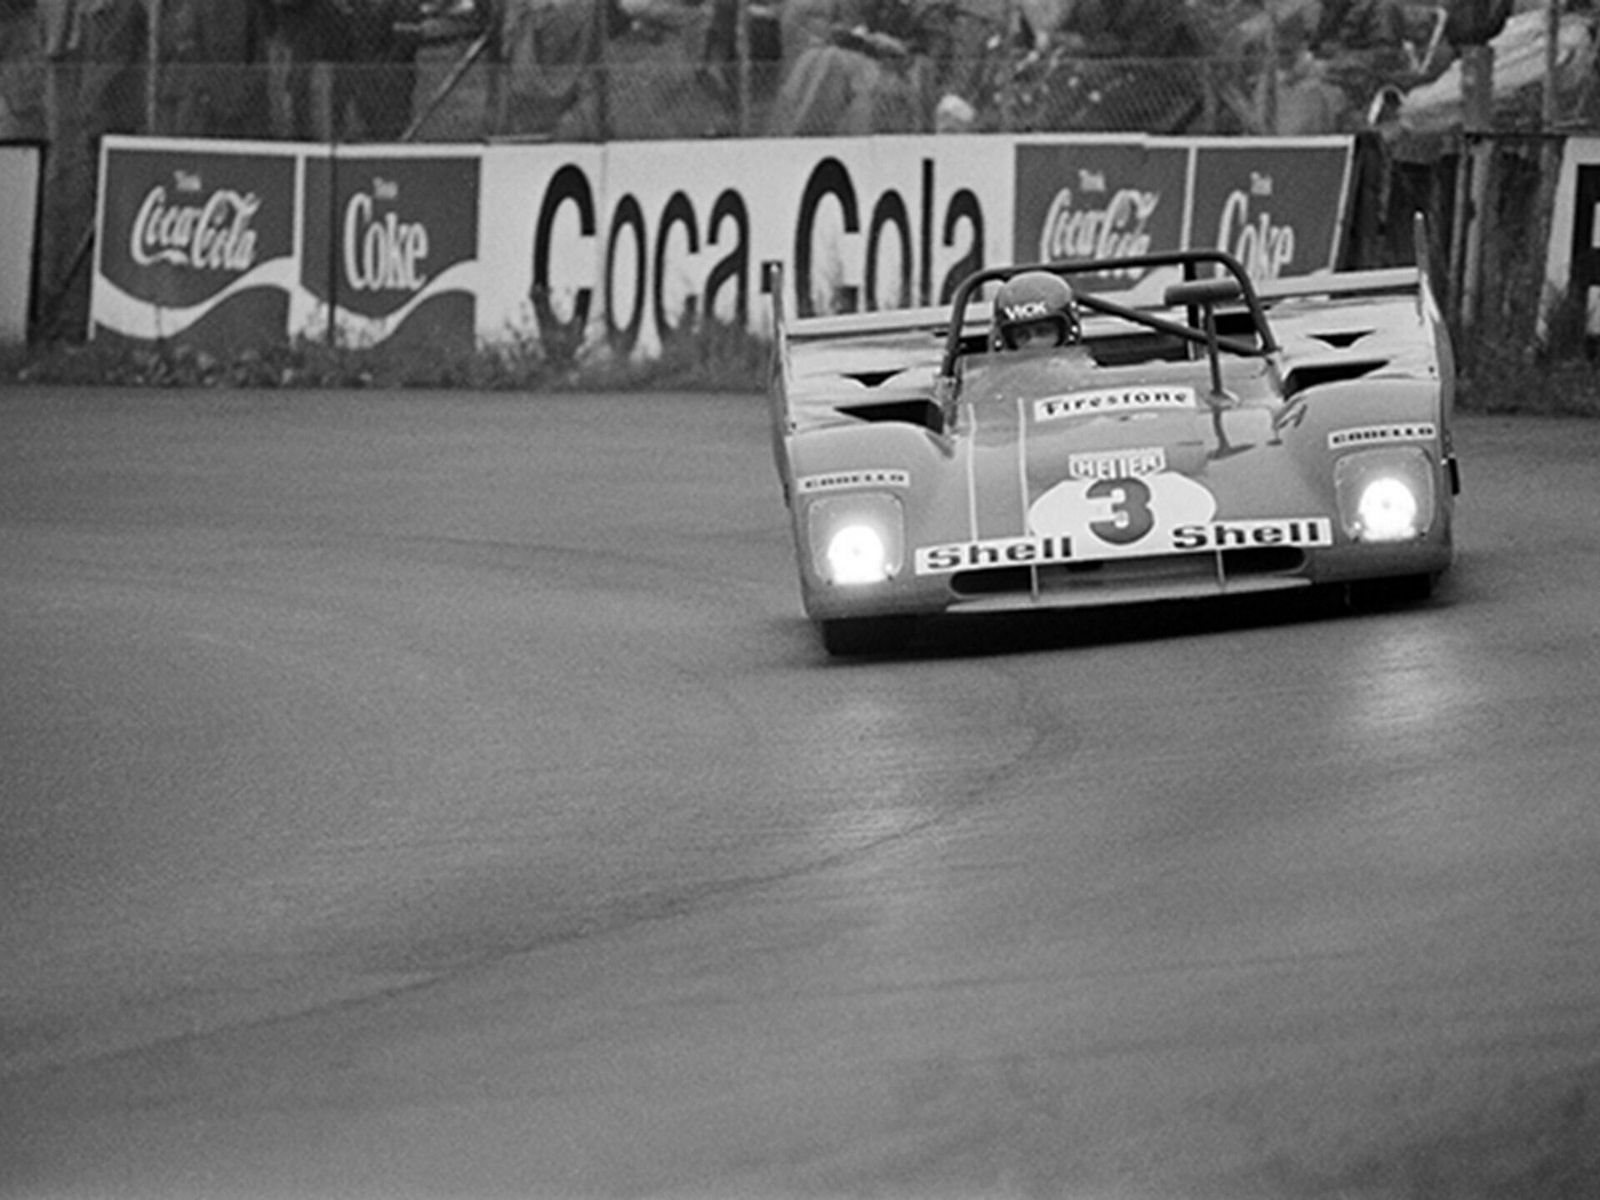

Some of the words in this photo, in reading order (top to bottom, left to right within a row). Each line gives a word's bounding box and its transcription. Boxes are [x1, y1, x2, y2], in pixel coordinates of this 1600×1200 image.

[343, 192, 429, 291] Coke
[532, 156, 986, 352] Coca-Cola
[1215, 189, 1295, 279] Coke
[1042, 391, 1188, 415] Firestone
[1085, 476, 1155, 545] 3
[1172, 522, 1320, 549] Shell
[926, 536, 1073, 569] Shell
